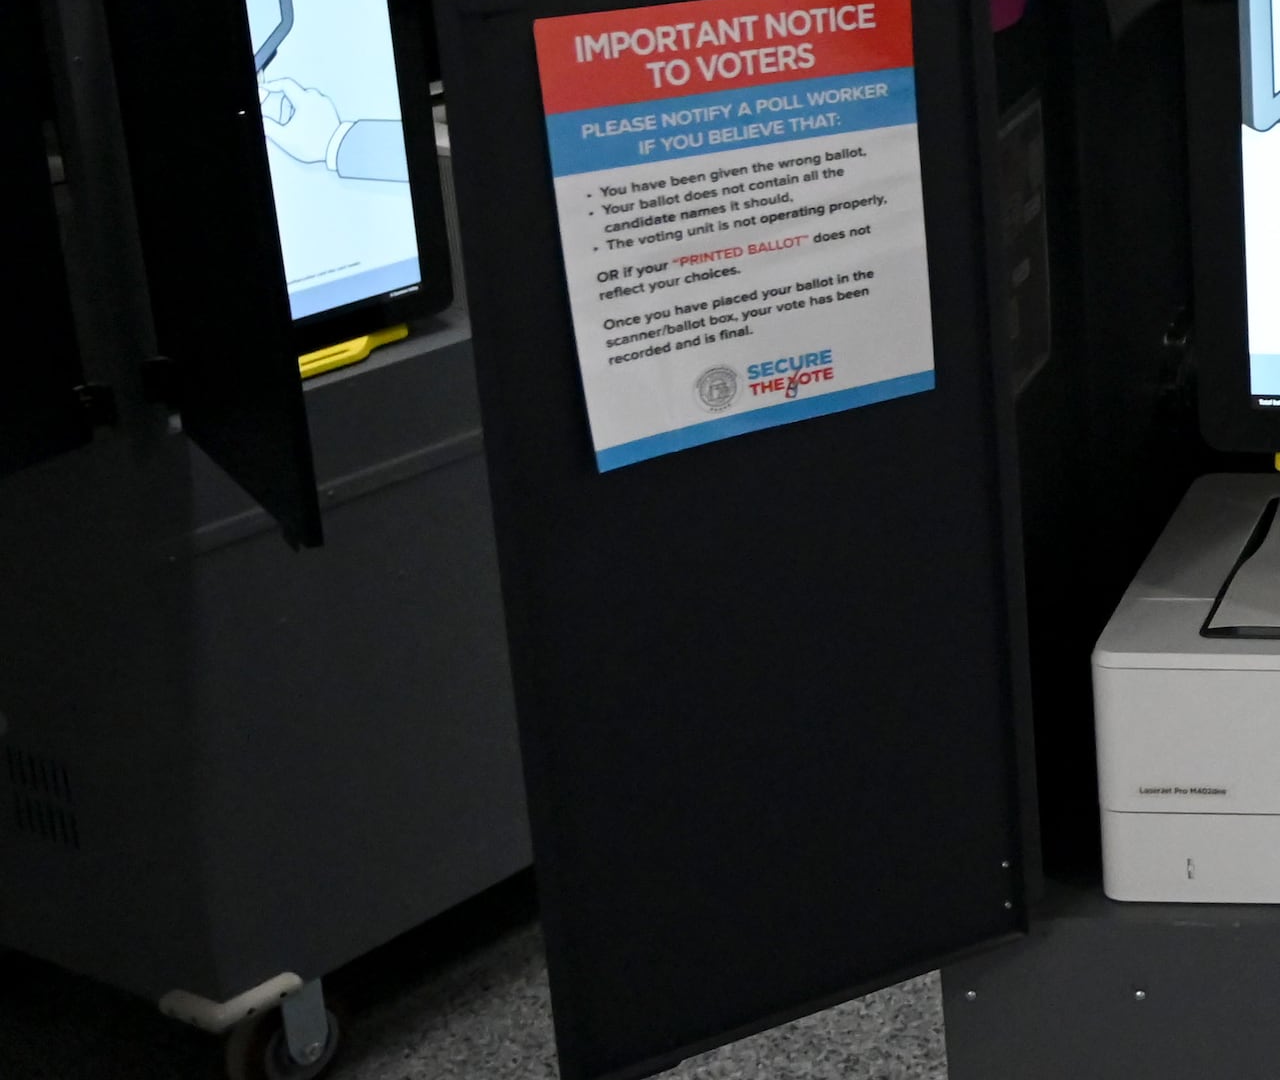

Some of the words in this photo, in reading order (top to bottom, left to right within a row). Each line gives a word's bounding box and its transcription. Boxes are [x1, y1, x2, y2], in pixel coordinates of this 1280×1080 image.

[574, 15, 759, 63] IMPORTANT
[765, 3, 876, 39] NOTICE
[646, 58, 690, 89] TO
[696, 43, 816, 82] VOTERS
[581, 114, 656, 140] PLEASE
[662, 103, 733, 129] NOTIFY
[737, 101, 752, 117] A
[756, 94, 804, 114] POLL
[806, 83, 888, 107] WORKER
[638, 139, 656, 155] IF
[660, 131, 702, 153] YOU
[708, 122, 784, 145] BELIEVE
[788, 113, 841, 134] THAT:
[600, 186, 627, 198] You
[630, 179, 666, 193] have
[670, 173, 706, 187] been
[710, 166, 748, 183] given
[752, 161, 774, 173] the
[778, 155, 822, 169] wrong
[601, 202, 635, 215] Your
[640, 194, 680, 210] ballot
[684, 188, 718, 202] does
[722, 182, 745, 196] not
[748, 173, 799, 191] contain
[803, 170, 819, 182] all
[822, 167, 844, 180] the
[604, 213, 676, 233] candidate
[680, 204, 726, 220] names
[730, 200, 740, 211] it
[606, 237, 634, 251] The
[638, 230, 684, 245] voting
[687, 222, 714, 237] unit
[718, 219, 730, 231] is
[733, 215, 756, 228] not
[760, 205, 825, 225] operating
[597, 269, 619, 283] OR
[623, 266, 633, 278] if
[636, 262, 668, 278] your
[813, 229, 846, 244] does
[850, 224, 872, 237] not
[599, 283, 645, 301] reflect
[648, 276, 680, 293] your
[684, 266, 742, 284] choices.
[603, 314, 641, 330] Once
[644, 309, 671, 324] you
[674, 300, 708, 315] have
[712, 290, 758, 310] placed
[762, 284, 792, 301] your
[796, 276, 834, 292] ballot
[836, 274, 850, 285] in
[852, 269, 874, 282] the
[606, 318, 706, 348] scanner/ballot
[709, 313, 738, 326] box,
[742, 305, 772, 322] your
[775, 298, 806, 312] vote
[809, 294, 834, 307] has
[836, 287, 870, 301] been
[608, 342, 672, 366] recorded
[676, 336, 701, 351] and
[704, 332, 716, 344] is
[720, 325, 754, 340] final.
[746, 349, 832, 380] SECURE
[1139, 786, 1172, 795] LaserJet
[1174, 786, 1188, 795] Pro
